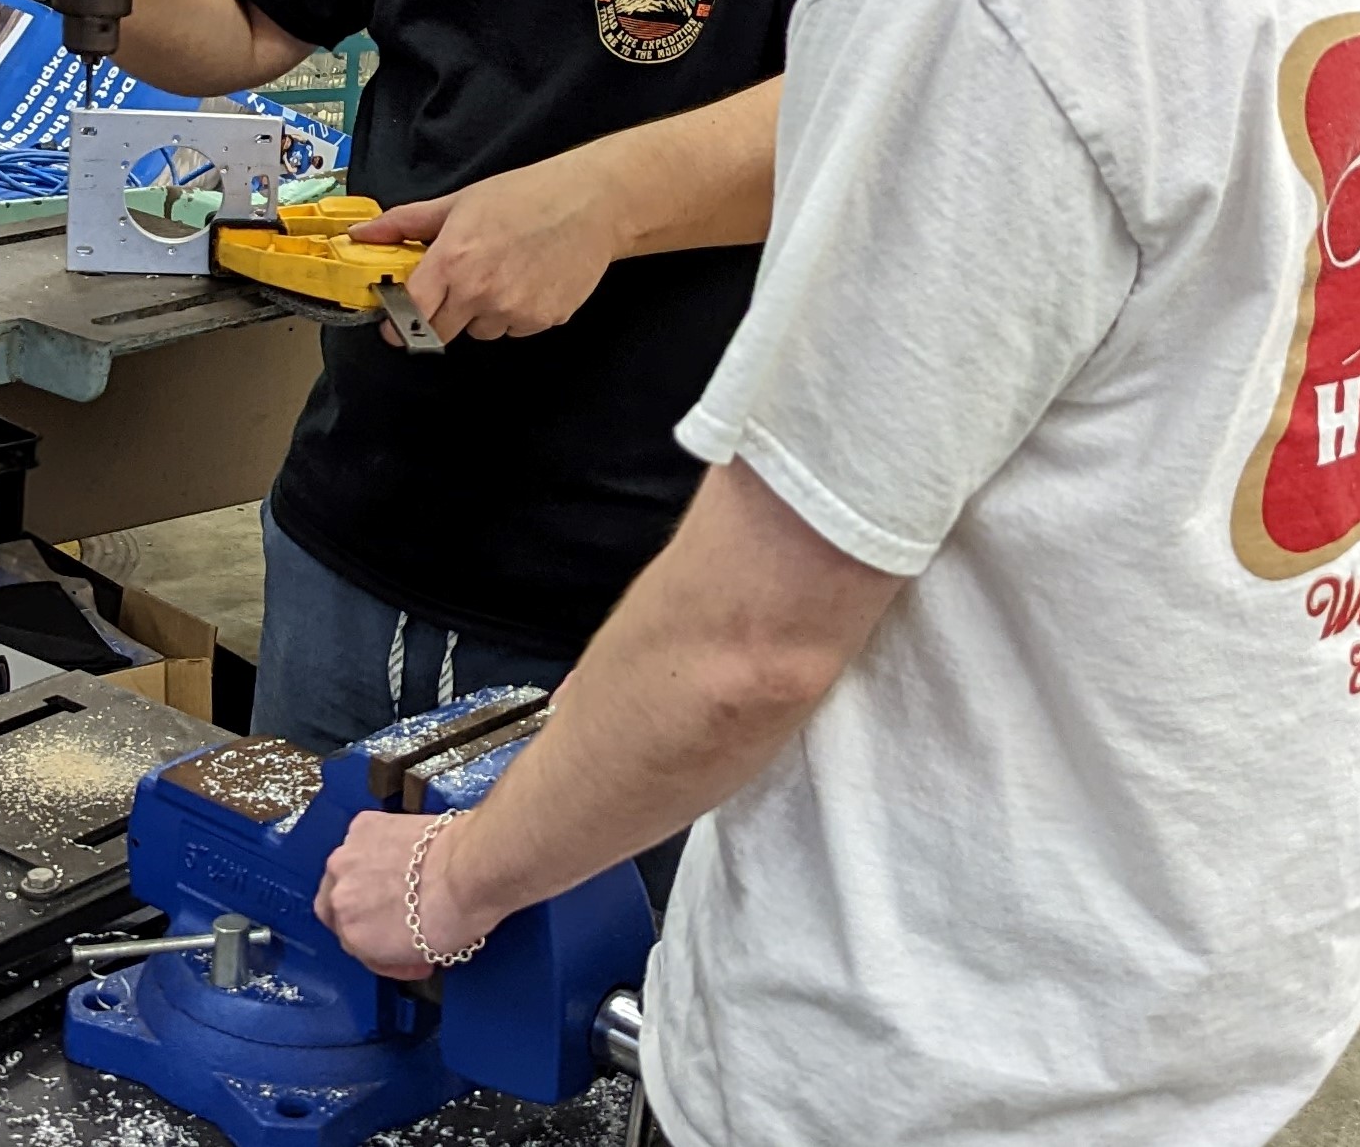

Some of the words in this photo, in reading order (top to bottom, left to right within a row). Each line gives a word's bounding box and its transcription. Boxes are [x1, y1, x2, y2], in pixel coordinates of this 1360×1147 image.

[605, 33, 619, 48] ME
[621, 46, 632, 57] TO
[635, 49, 653, 60] THE
[657, 21, 704, 59] MOUNTAINS
[607, 3, 618, 31] WILD
[616, 30, 638, 48] LIFE
[642, 17, 698, 50] EXPEDITION
[2, 45, 68, 131] explorers
[95, 65, 120, 99] ext
